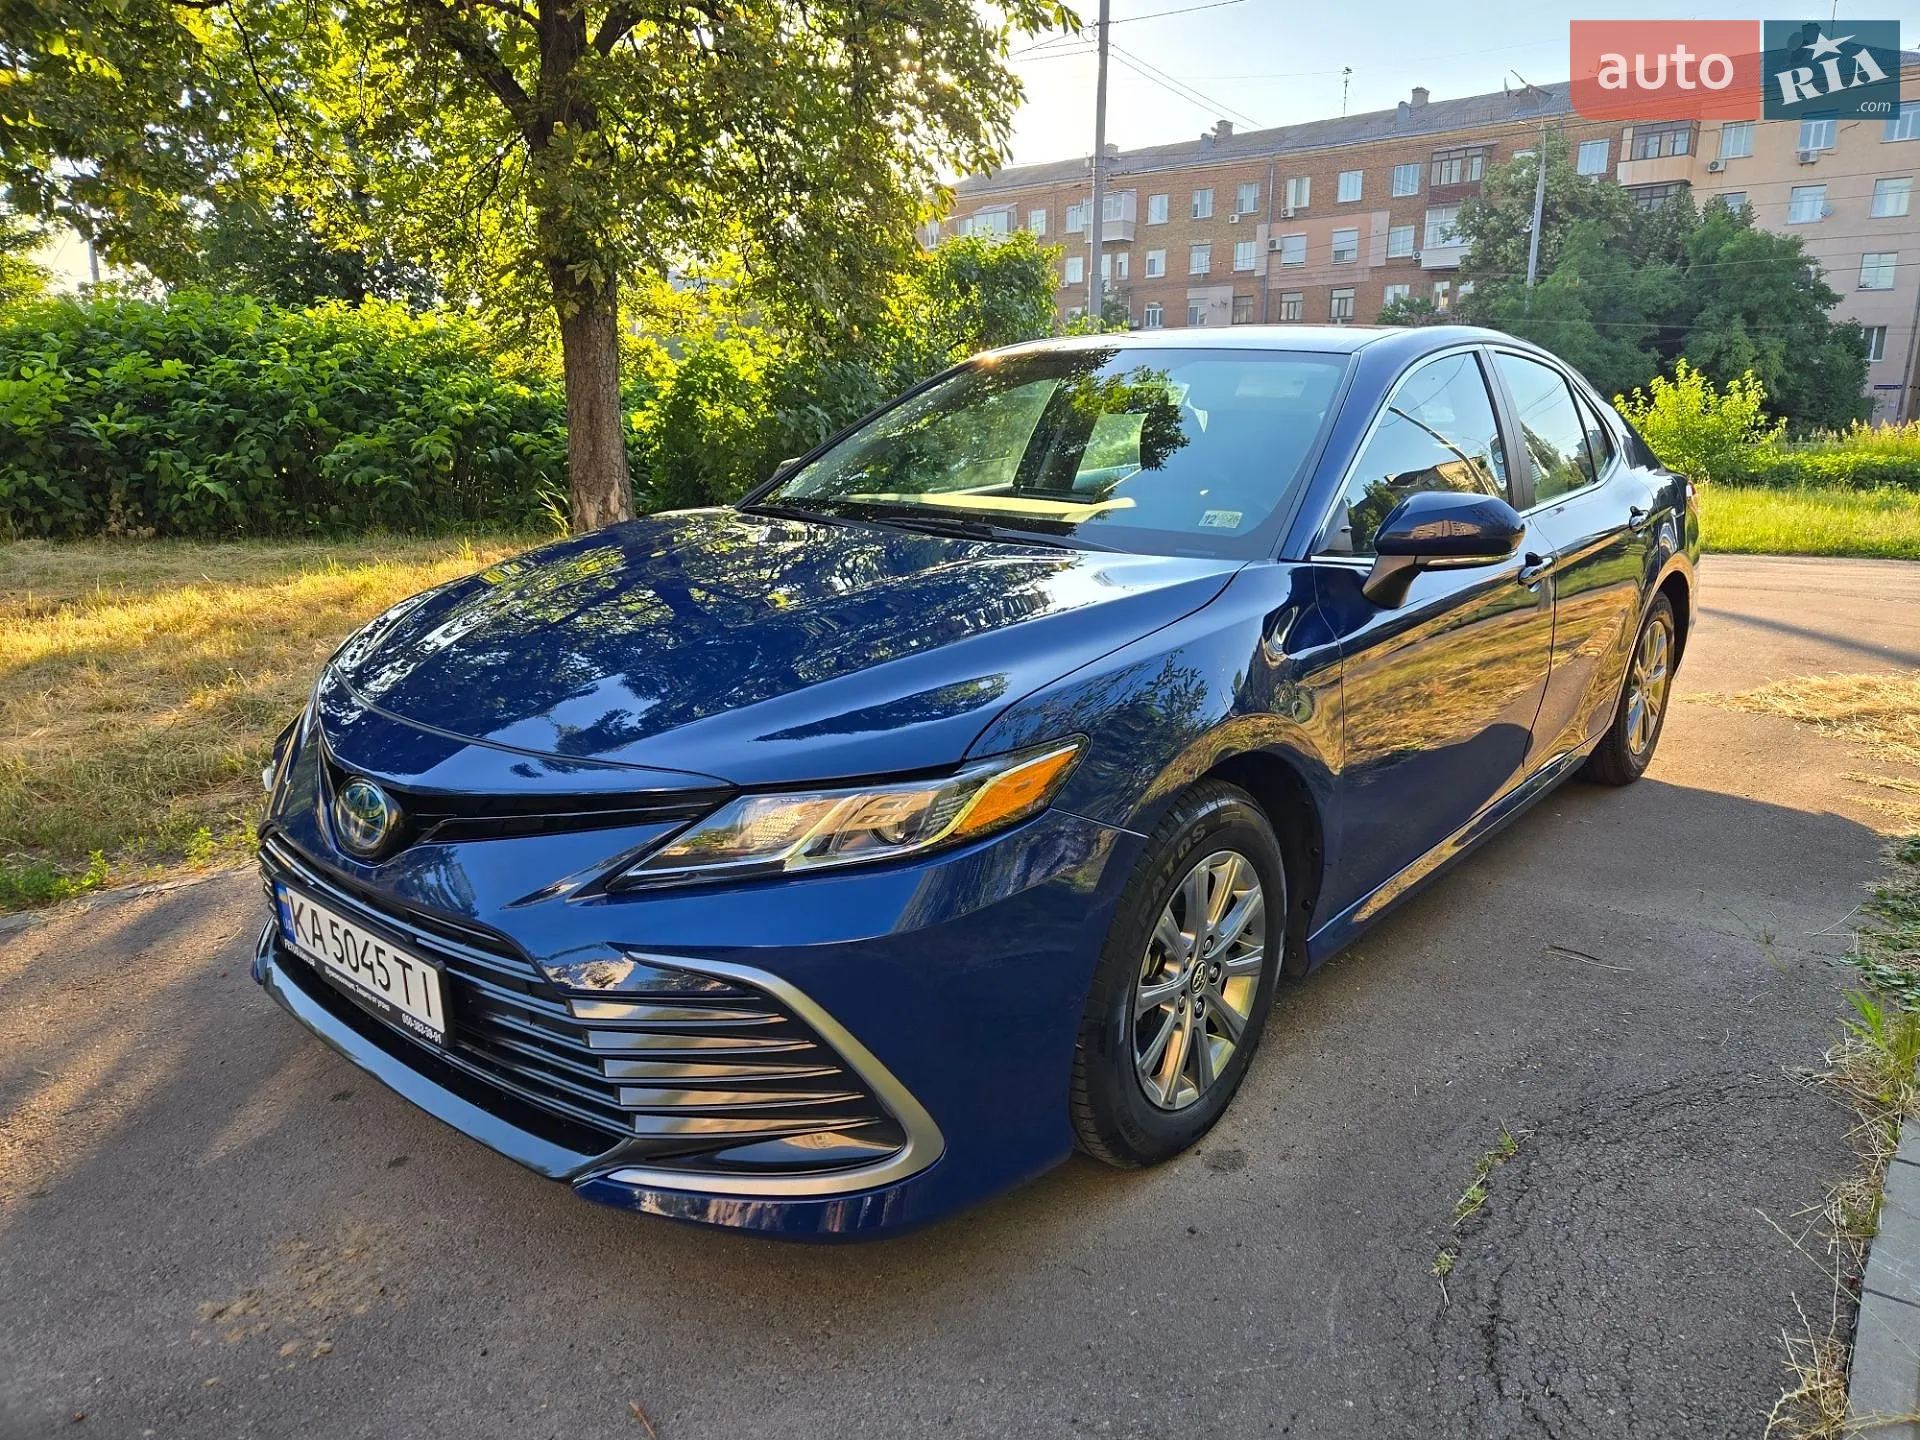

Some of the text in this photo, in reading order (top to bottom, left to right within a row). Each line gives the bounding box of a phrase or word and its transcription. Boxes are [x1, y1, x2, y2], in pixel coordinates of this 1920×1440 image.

[289, 895, 433, 1019] KA 5045 TI
